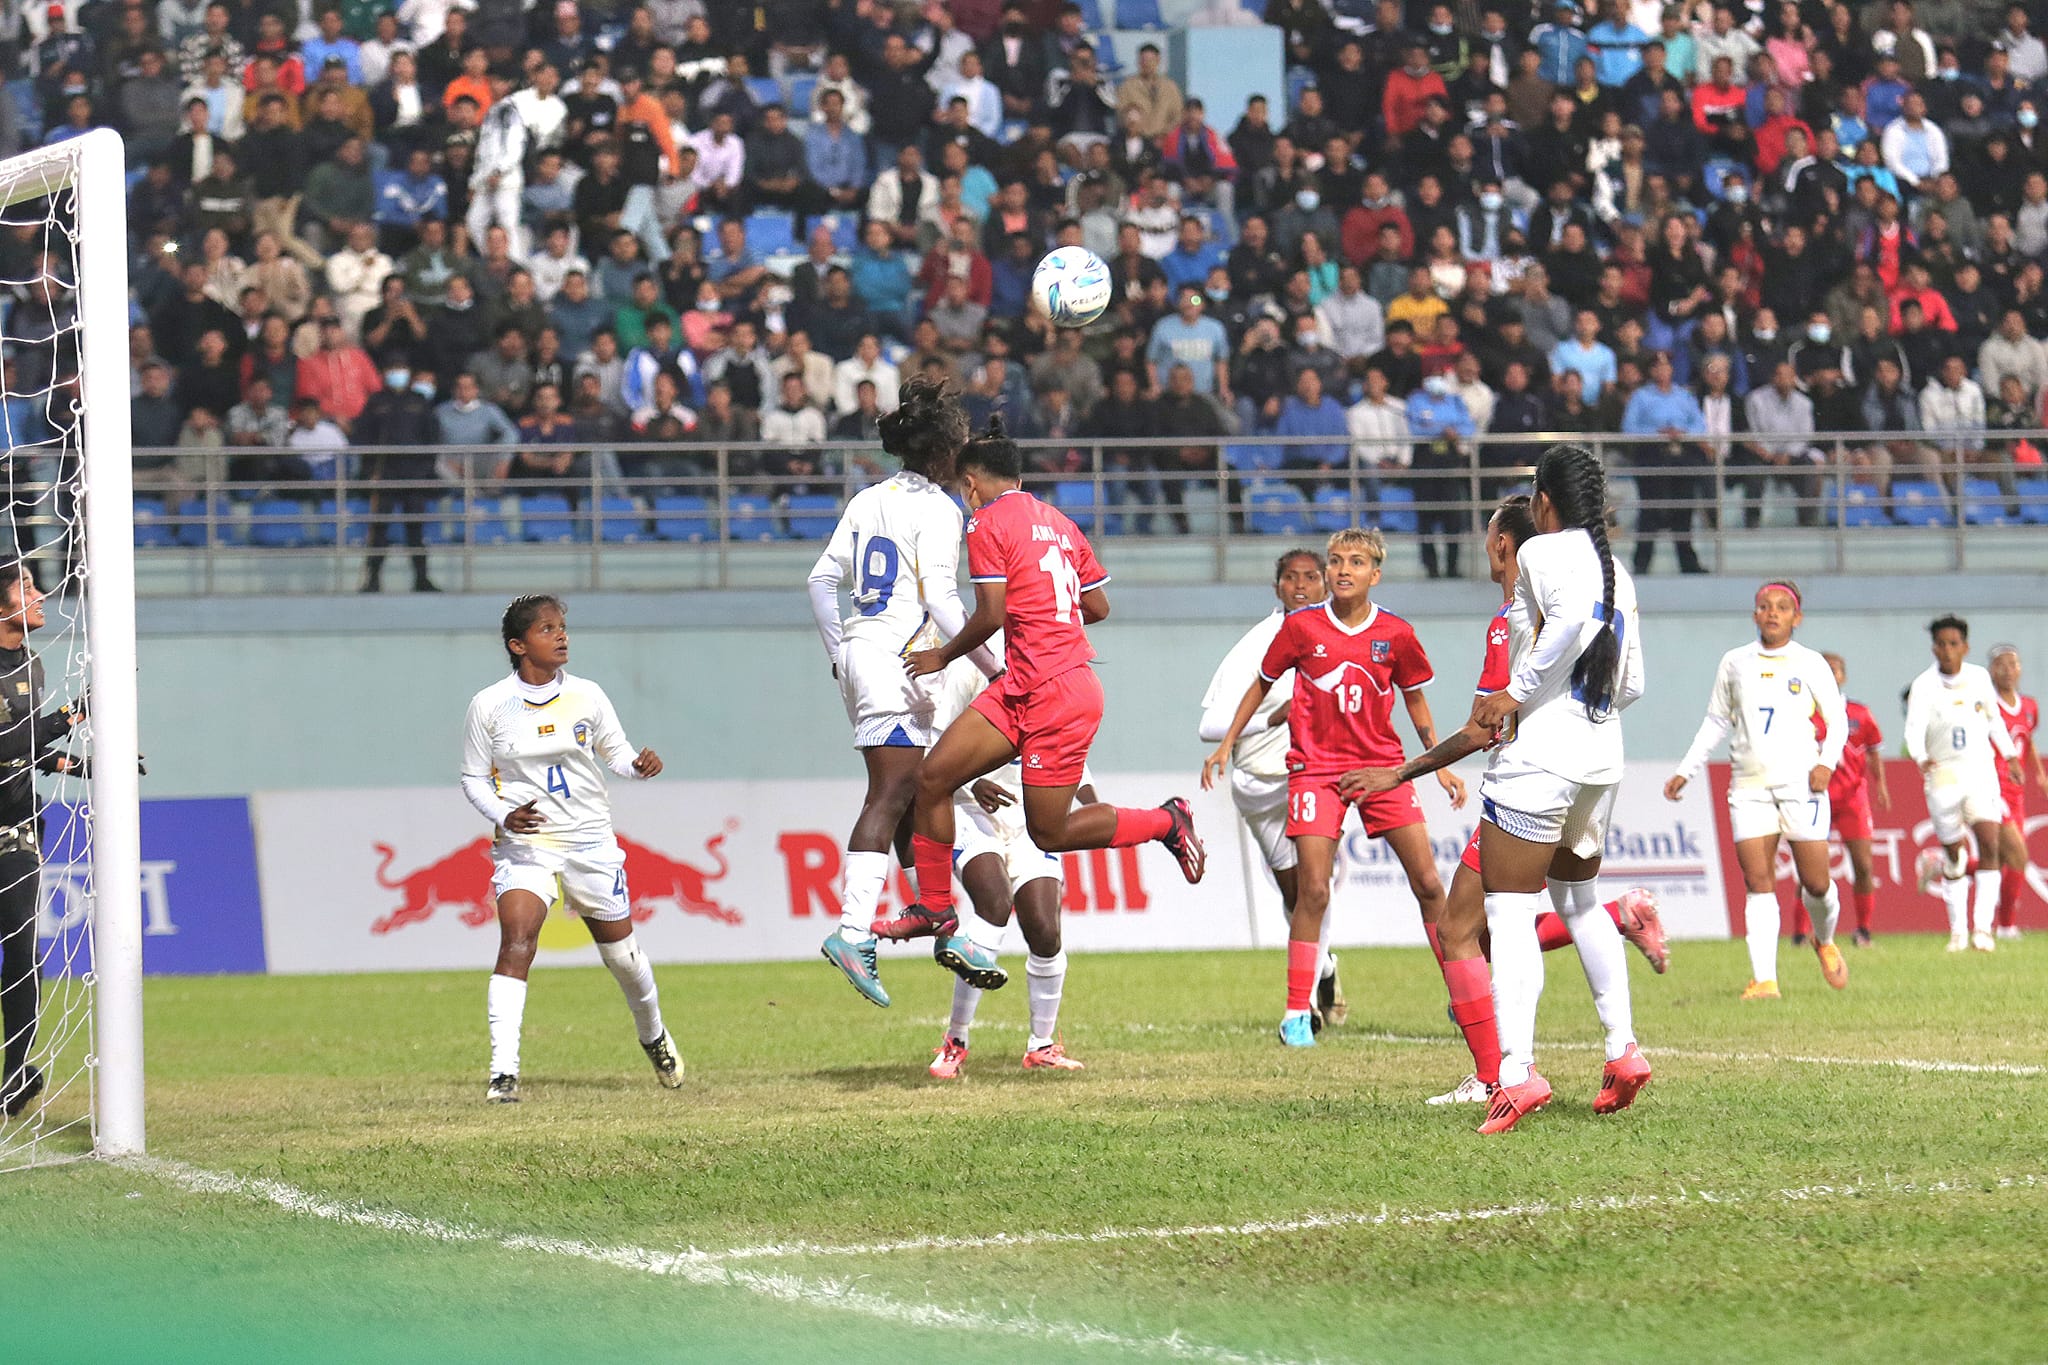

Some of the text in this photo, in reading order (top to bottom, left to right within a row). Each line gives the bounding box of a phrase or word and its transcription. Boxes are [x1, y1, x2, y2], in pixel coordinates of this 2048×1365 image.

[1335, 684, 1363, 714] 13
[1759, 707, 1775, 735] 7
[1952, 726, 1966, 750] 8
[547, 764, 571, 799] 4
[1293, 791, 1316, 822] 13
[1808, 800, 1820, 826] 7
[1604, 820, 1701, 857] Bank
[612, 869, 626, 903] 4
